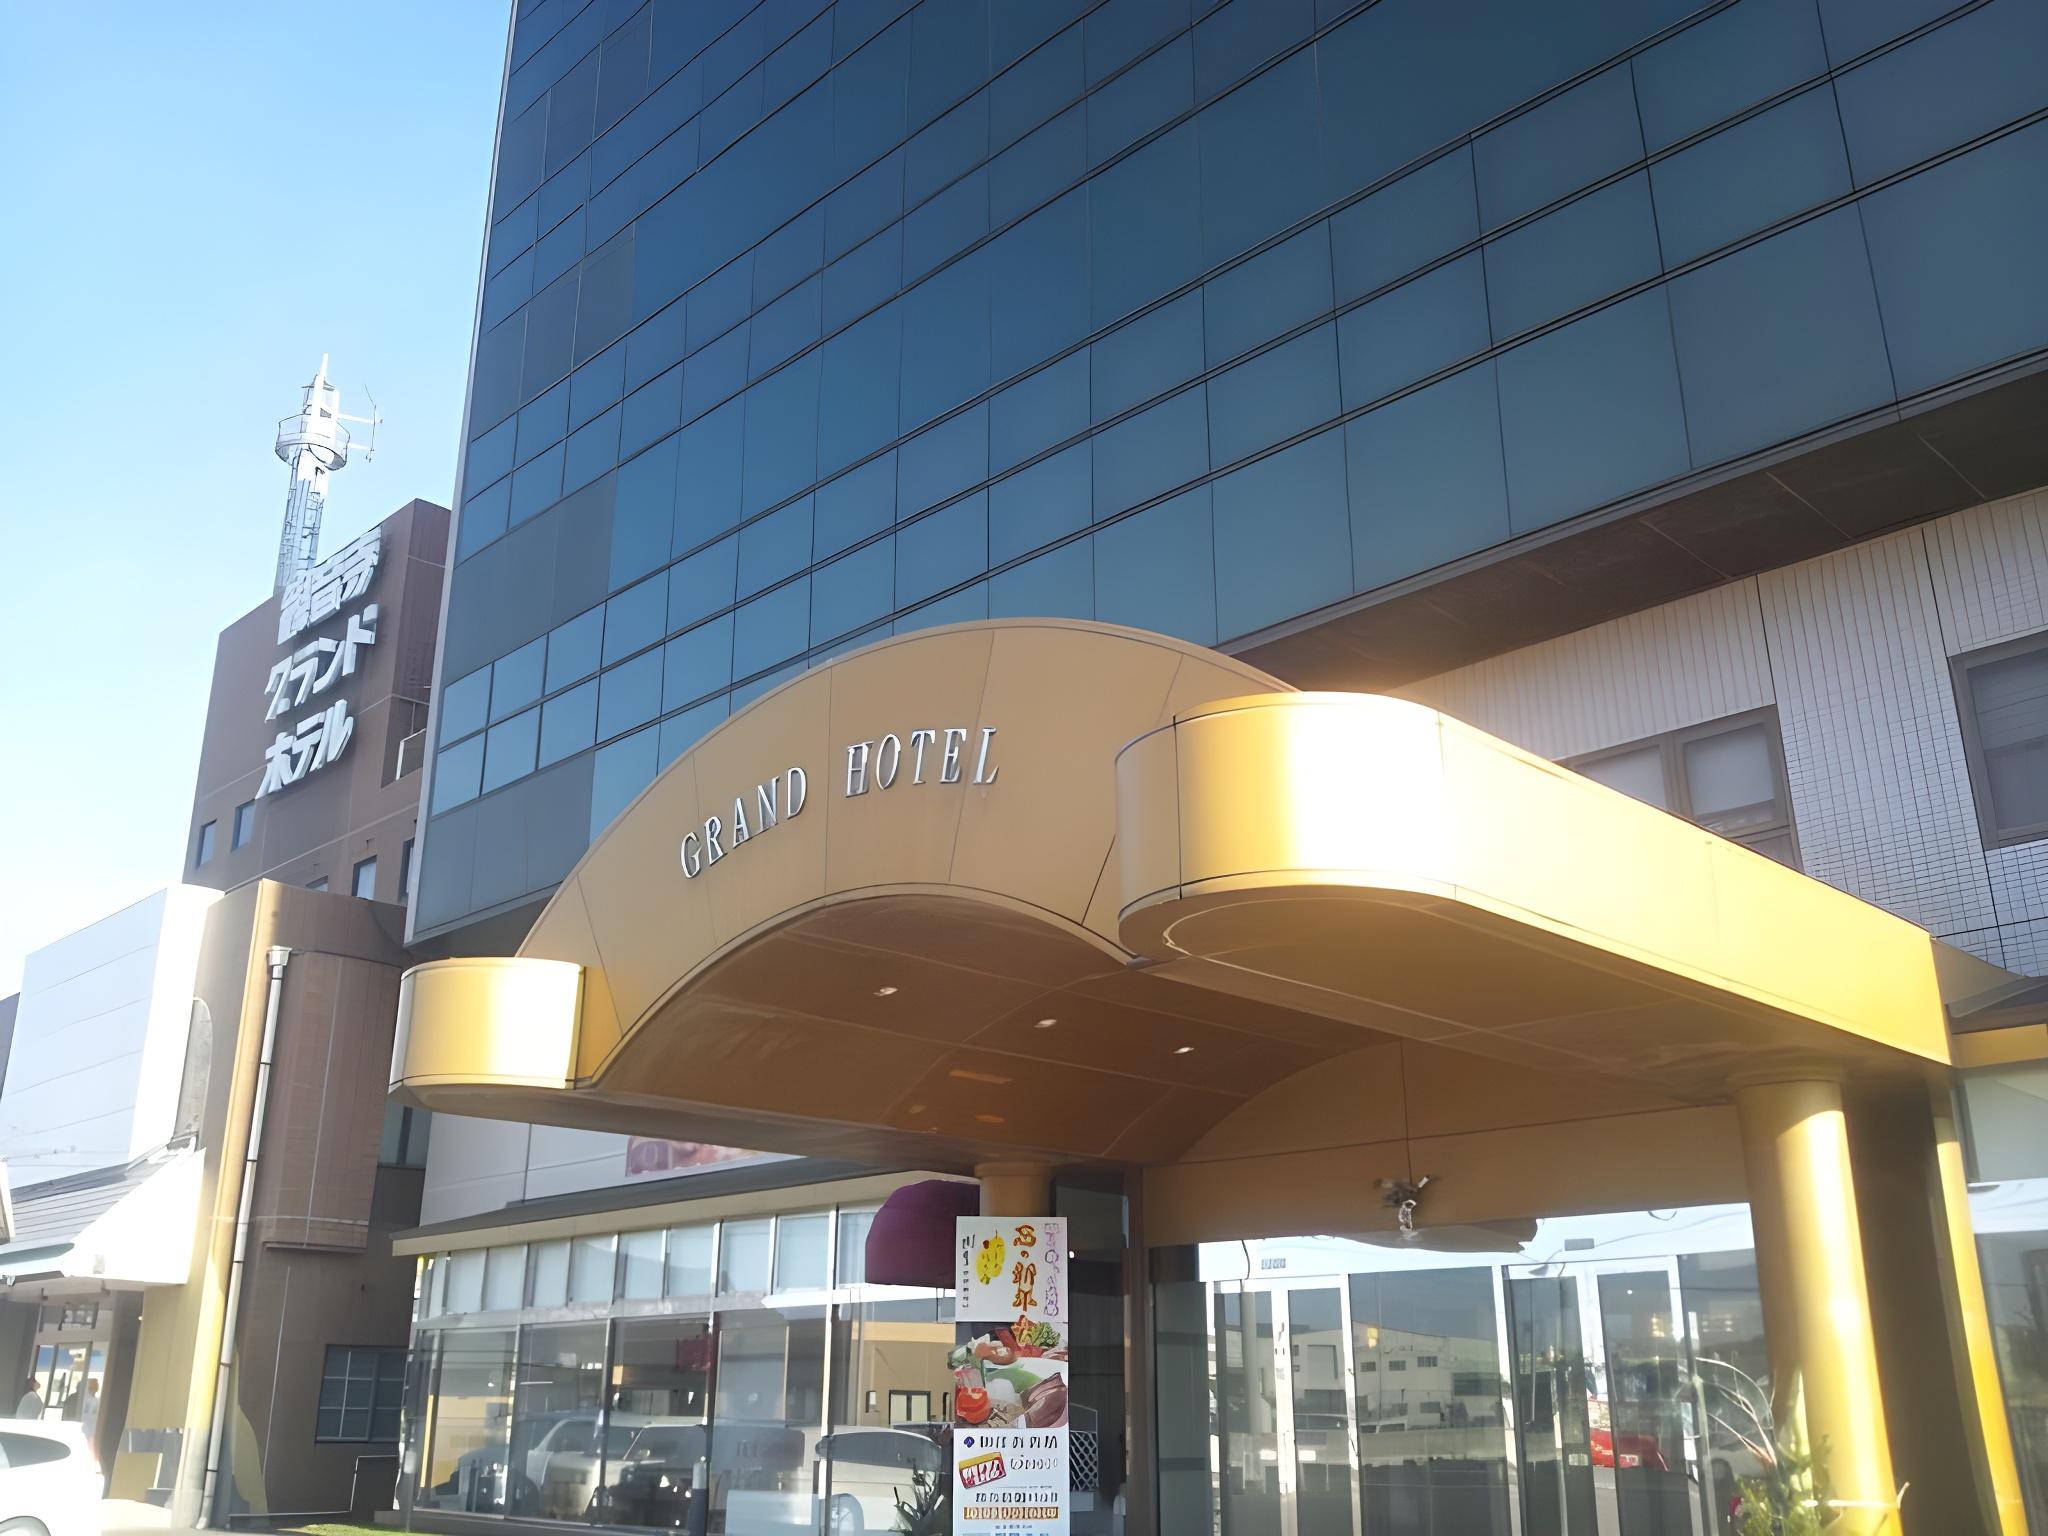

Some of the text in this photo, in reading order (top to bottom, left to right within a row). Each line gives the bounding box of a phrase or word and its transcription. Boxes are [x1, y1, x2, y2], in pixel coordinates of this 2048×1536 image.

[264, 603, 379, 722] グランド
[255, 699, 354, 800] ホテル
[679, 727, 1000, 880] GRAND HOTEL
